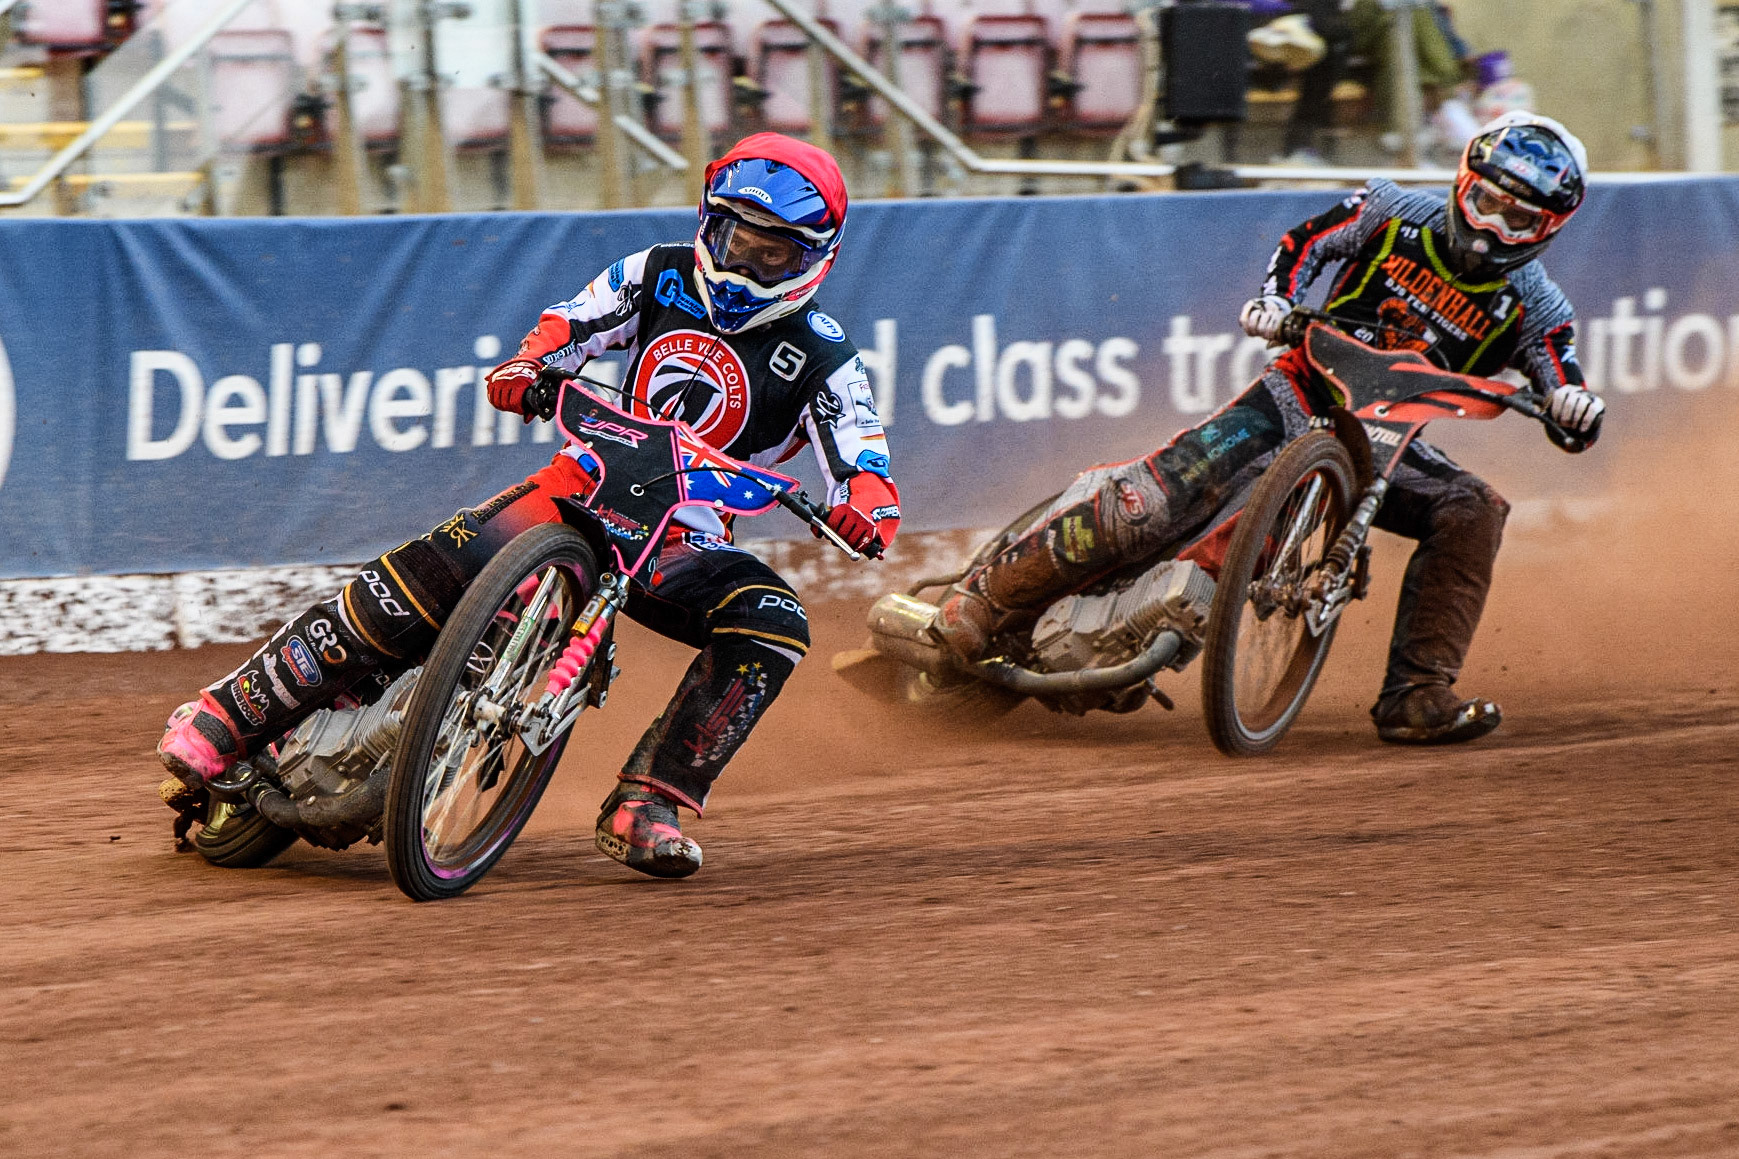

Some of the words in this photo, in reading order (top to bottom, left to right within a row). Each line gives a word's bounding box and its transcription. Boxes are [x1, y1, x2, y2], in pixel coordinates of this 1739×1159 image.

[1494, 295, 1513, 320] 1
[652, 339, 694, 361] BELLE
[698, 341, 725, 363] VUE
[722, 363, 742, 409] COLTS
[772, 345, 803, 376] 5
[126, 336, 620, 462] Deliverin
[922, 314, 1141, 425] class
[360, 570, 411, 616] pod
[290, 644, 317, 678] STE
